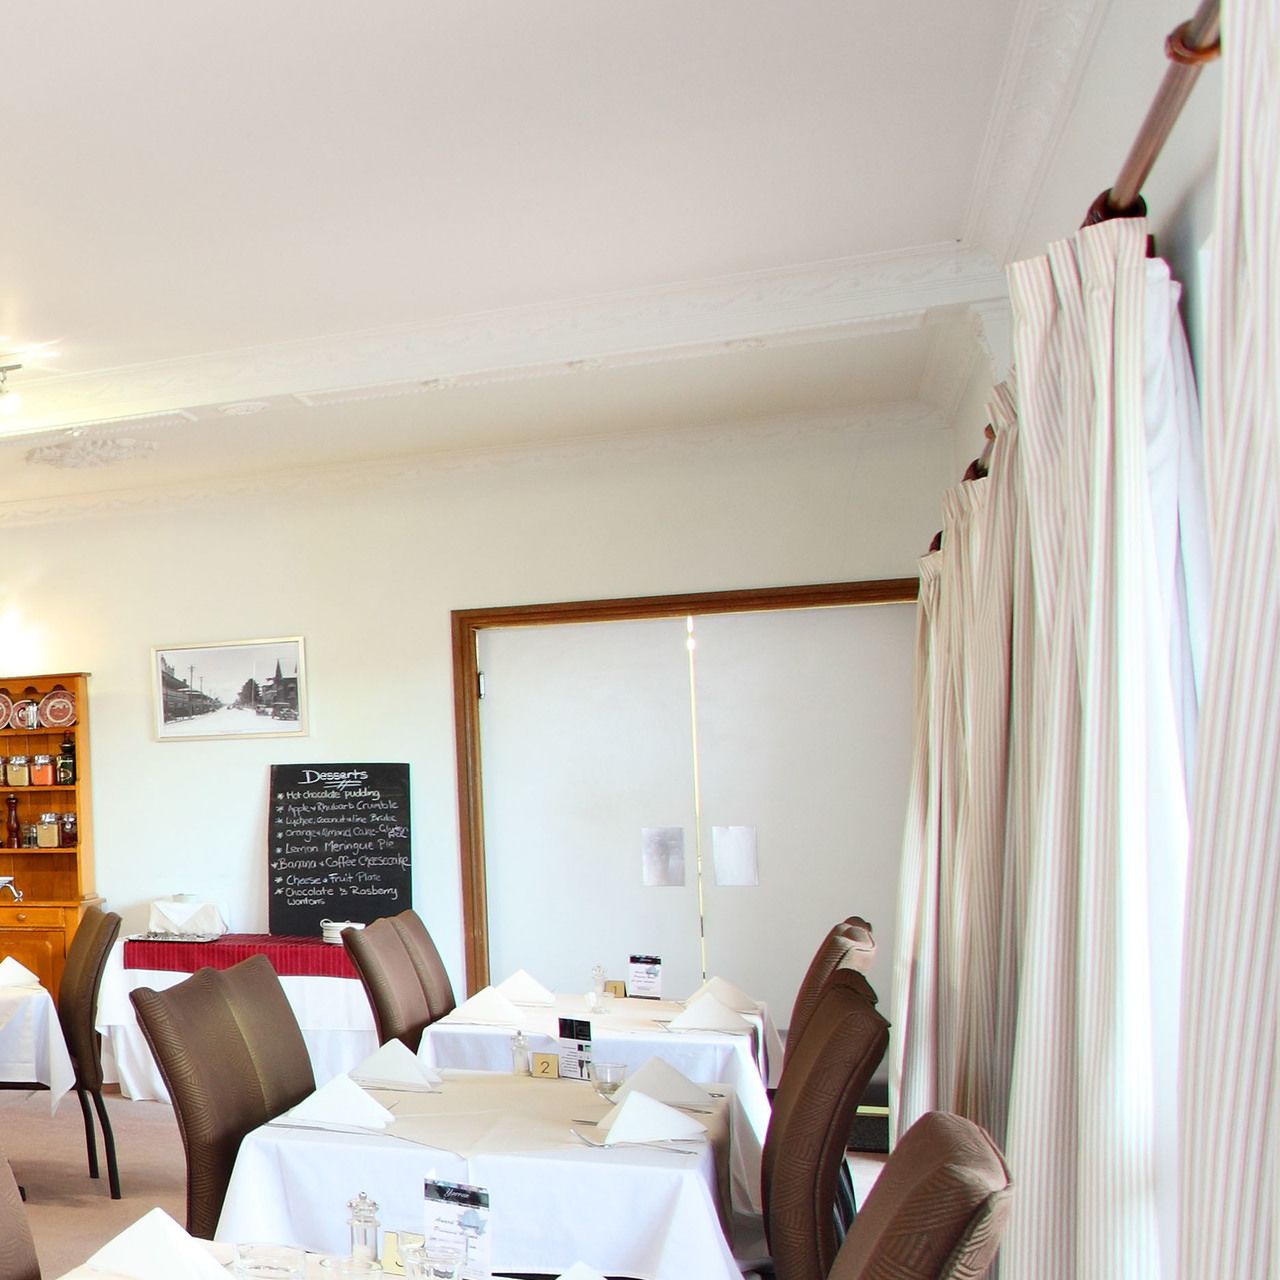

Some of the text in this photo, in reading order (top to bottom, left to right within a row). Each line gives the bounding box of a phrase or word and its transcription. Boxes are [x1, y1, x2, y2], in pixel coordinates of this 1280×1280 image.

[298, 769, 369, 784] Desserts
[286, 787, 380, 801] Hot chocolate pudding
[288, 803, 310, 817] Apple
[316, 802, 354, 812] Rhubarb
[356, 800, 399, 810] Crumble
[285, 829, 317, 842] Orange
[286, 838, 394, 855] Lemon Meringue Pie
[277, 858, 317, 870] Banana
[325, 856, 357, 868] Coffee
[286, 874, 321, 886] Cheese
[328, 873, 354, 882] Fruit
[356, 872, 382, 882] Plate
[285, 887, 334, 897] Chocolate
[540, 1060, 550, 1073] 2
